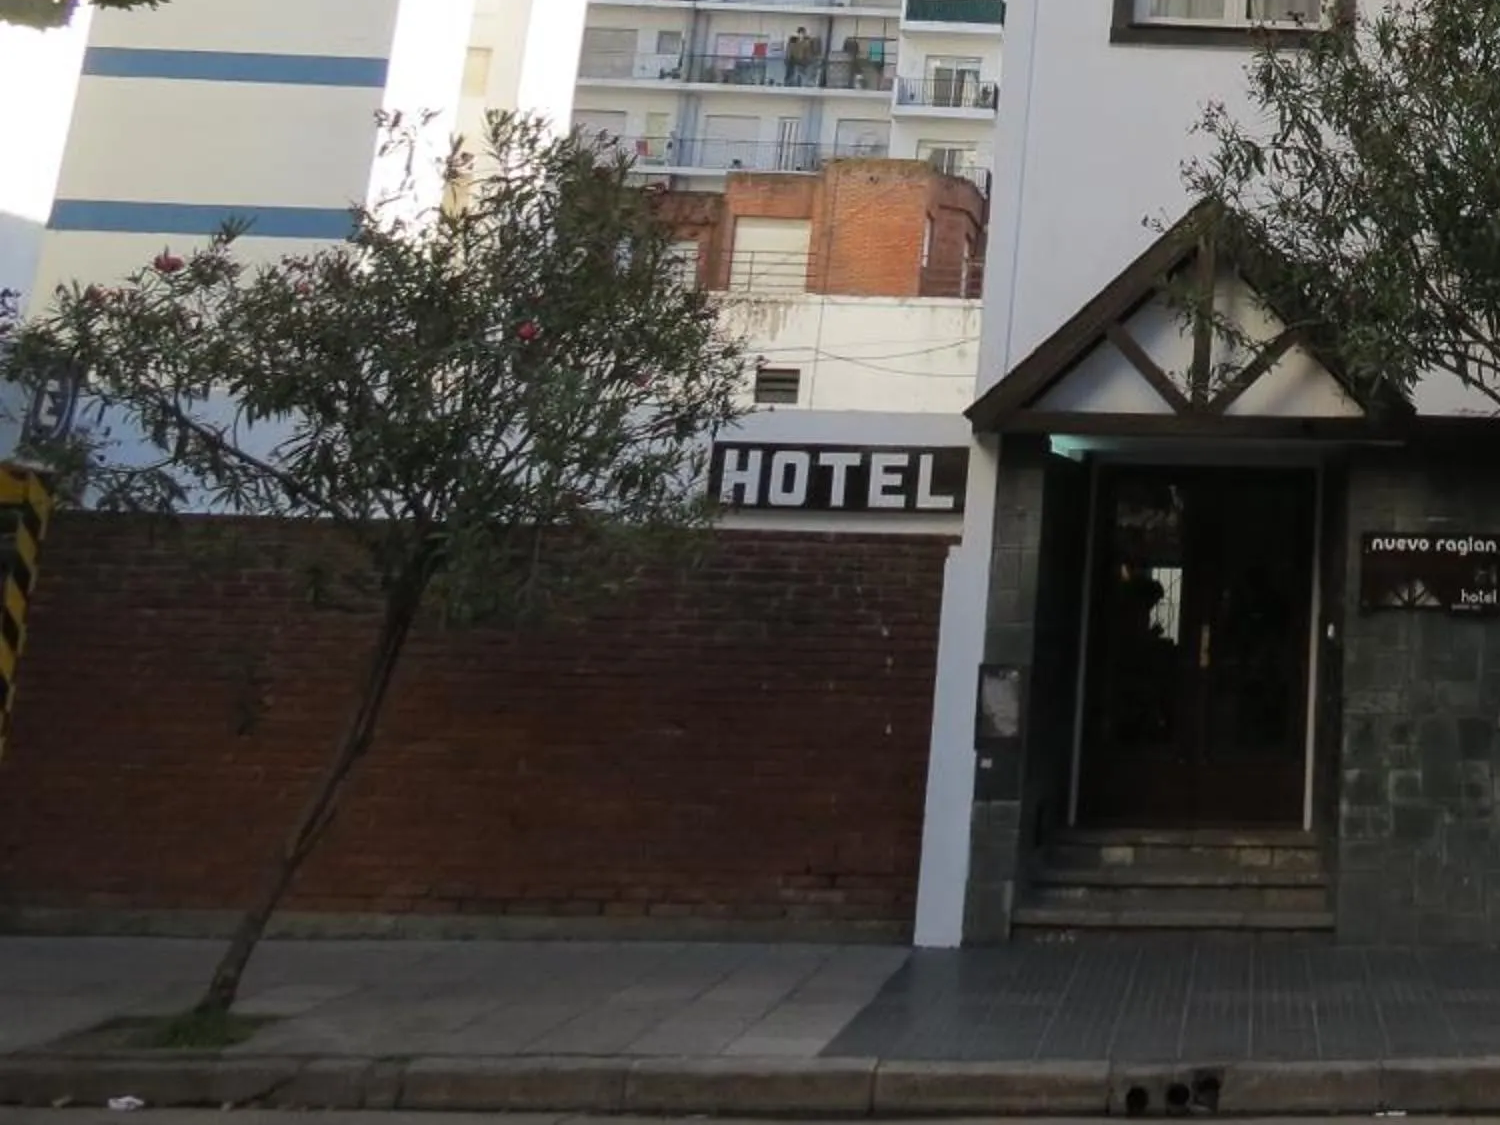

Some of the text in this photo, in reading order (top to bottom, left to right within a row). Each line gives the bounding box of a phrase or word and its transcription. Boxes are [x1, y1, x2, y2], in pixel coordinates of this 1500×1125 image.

[719, 448, 954, 509] HOTEL
[1372, 536, 1497, 556] nuevo raglan
[1461, 588, 1497, 603] hotel
